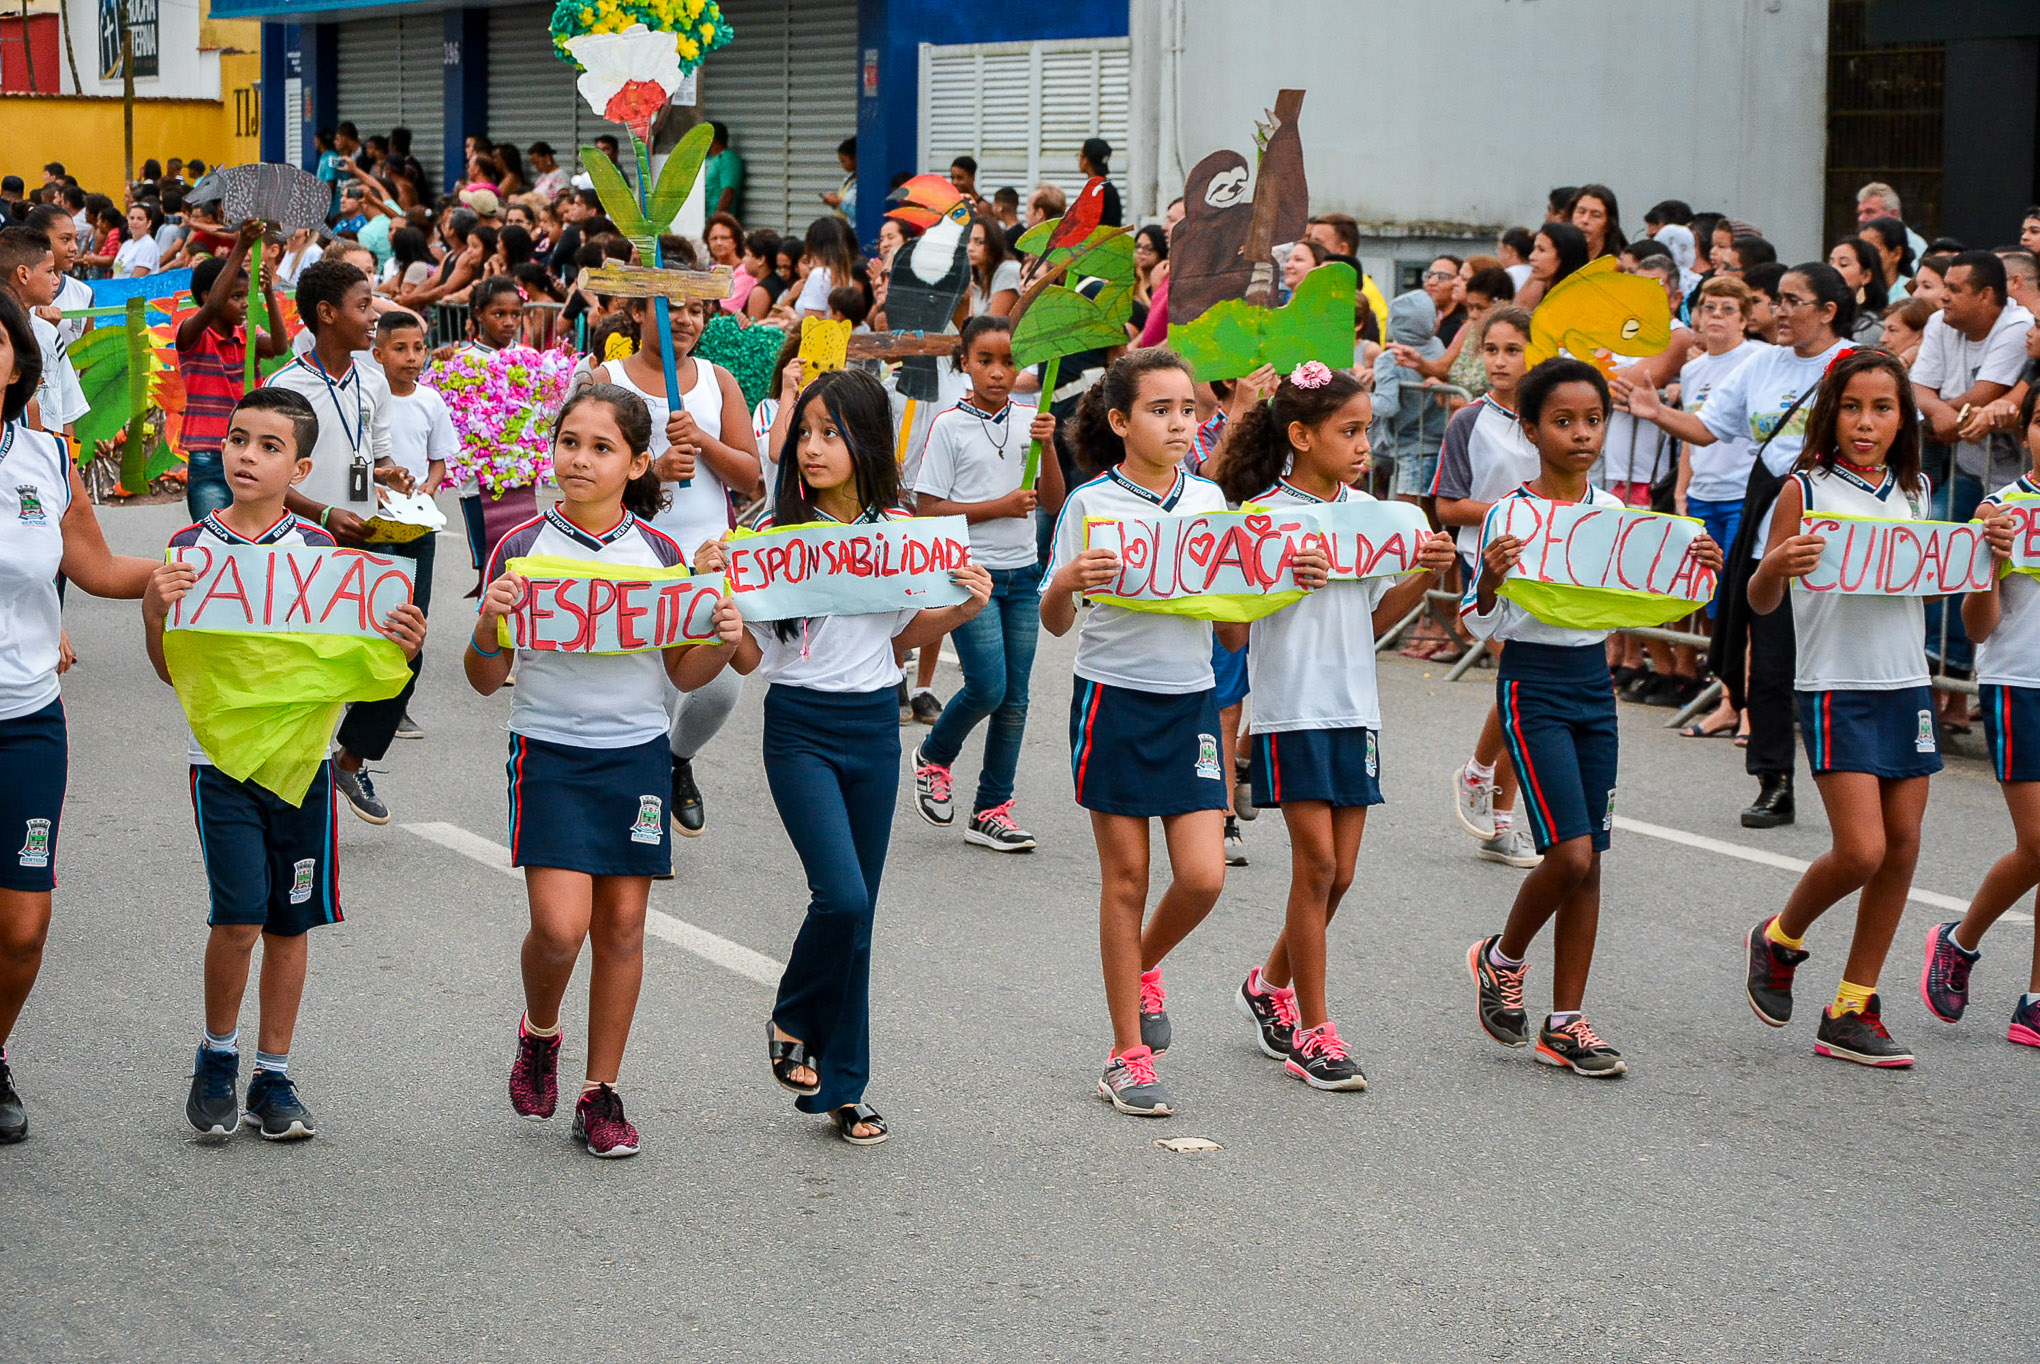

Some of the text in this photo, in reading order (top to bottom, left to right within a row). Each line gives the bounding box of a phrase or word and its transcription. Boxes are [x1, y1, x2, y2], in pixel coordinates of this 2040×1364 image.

[0, 431, 12, 461] RTIOGA
[1117, 478, 1152, 499] BERTIOGA
[173, 546, 414, 634] PAIXÃO
[720, 532, 972, 593] ESPONSABILIDADE
[1801, 519, 1996, 594] CUIDADO
[504, 575, 722, 652] RESPEITO
